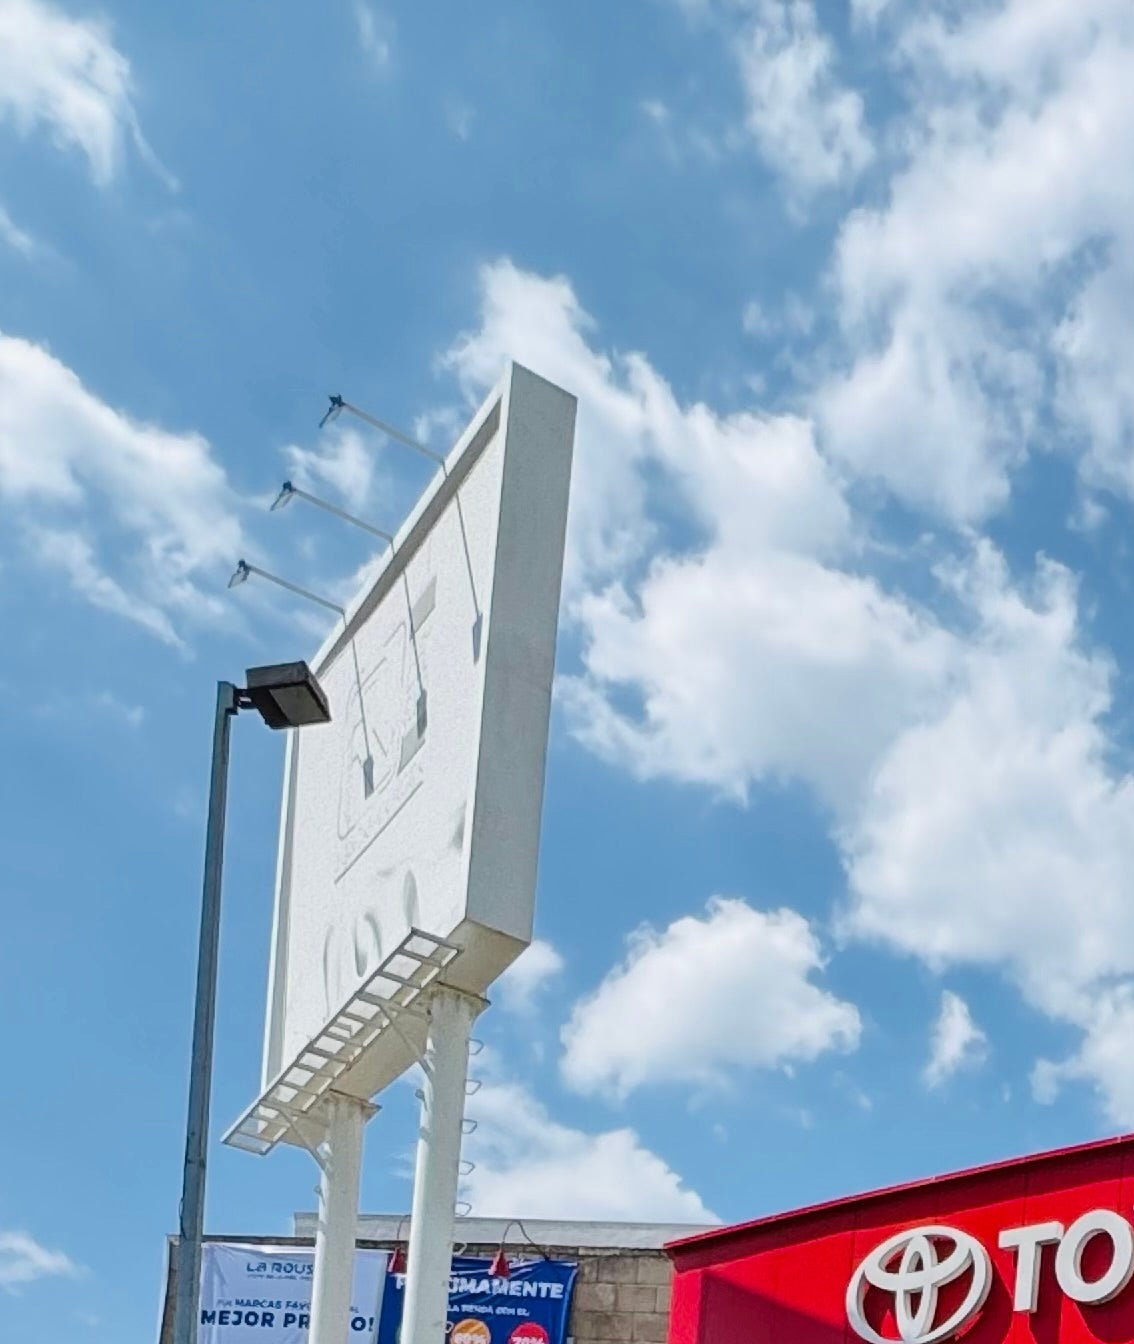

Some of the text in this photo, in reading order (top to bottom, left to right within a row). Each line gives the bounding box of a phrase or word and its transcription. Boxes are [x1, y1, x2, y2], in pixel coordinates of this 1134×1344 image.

[271, 1262, 313, 1275] ROUS
[200, 1309, 375, 1332] MEJOR PRO!
